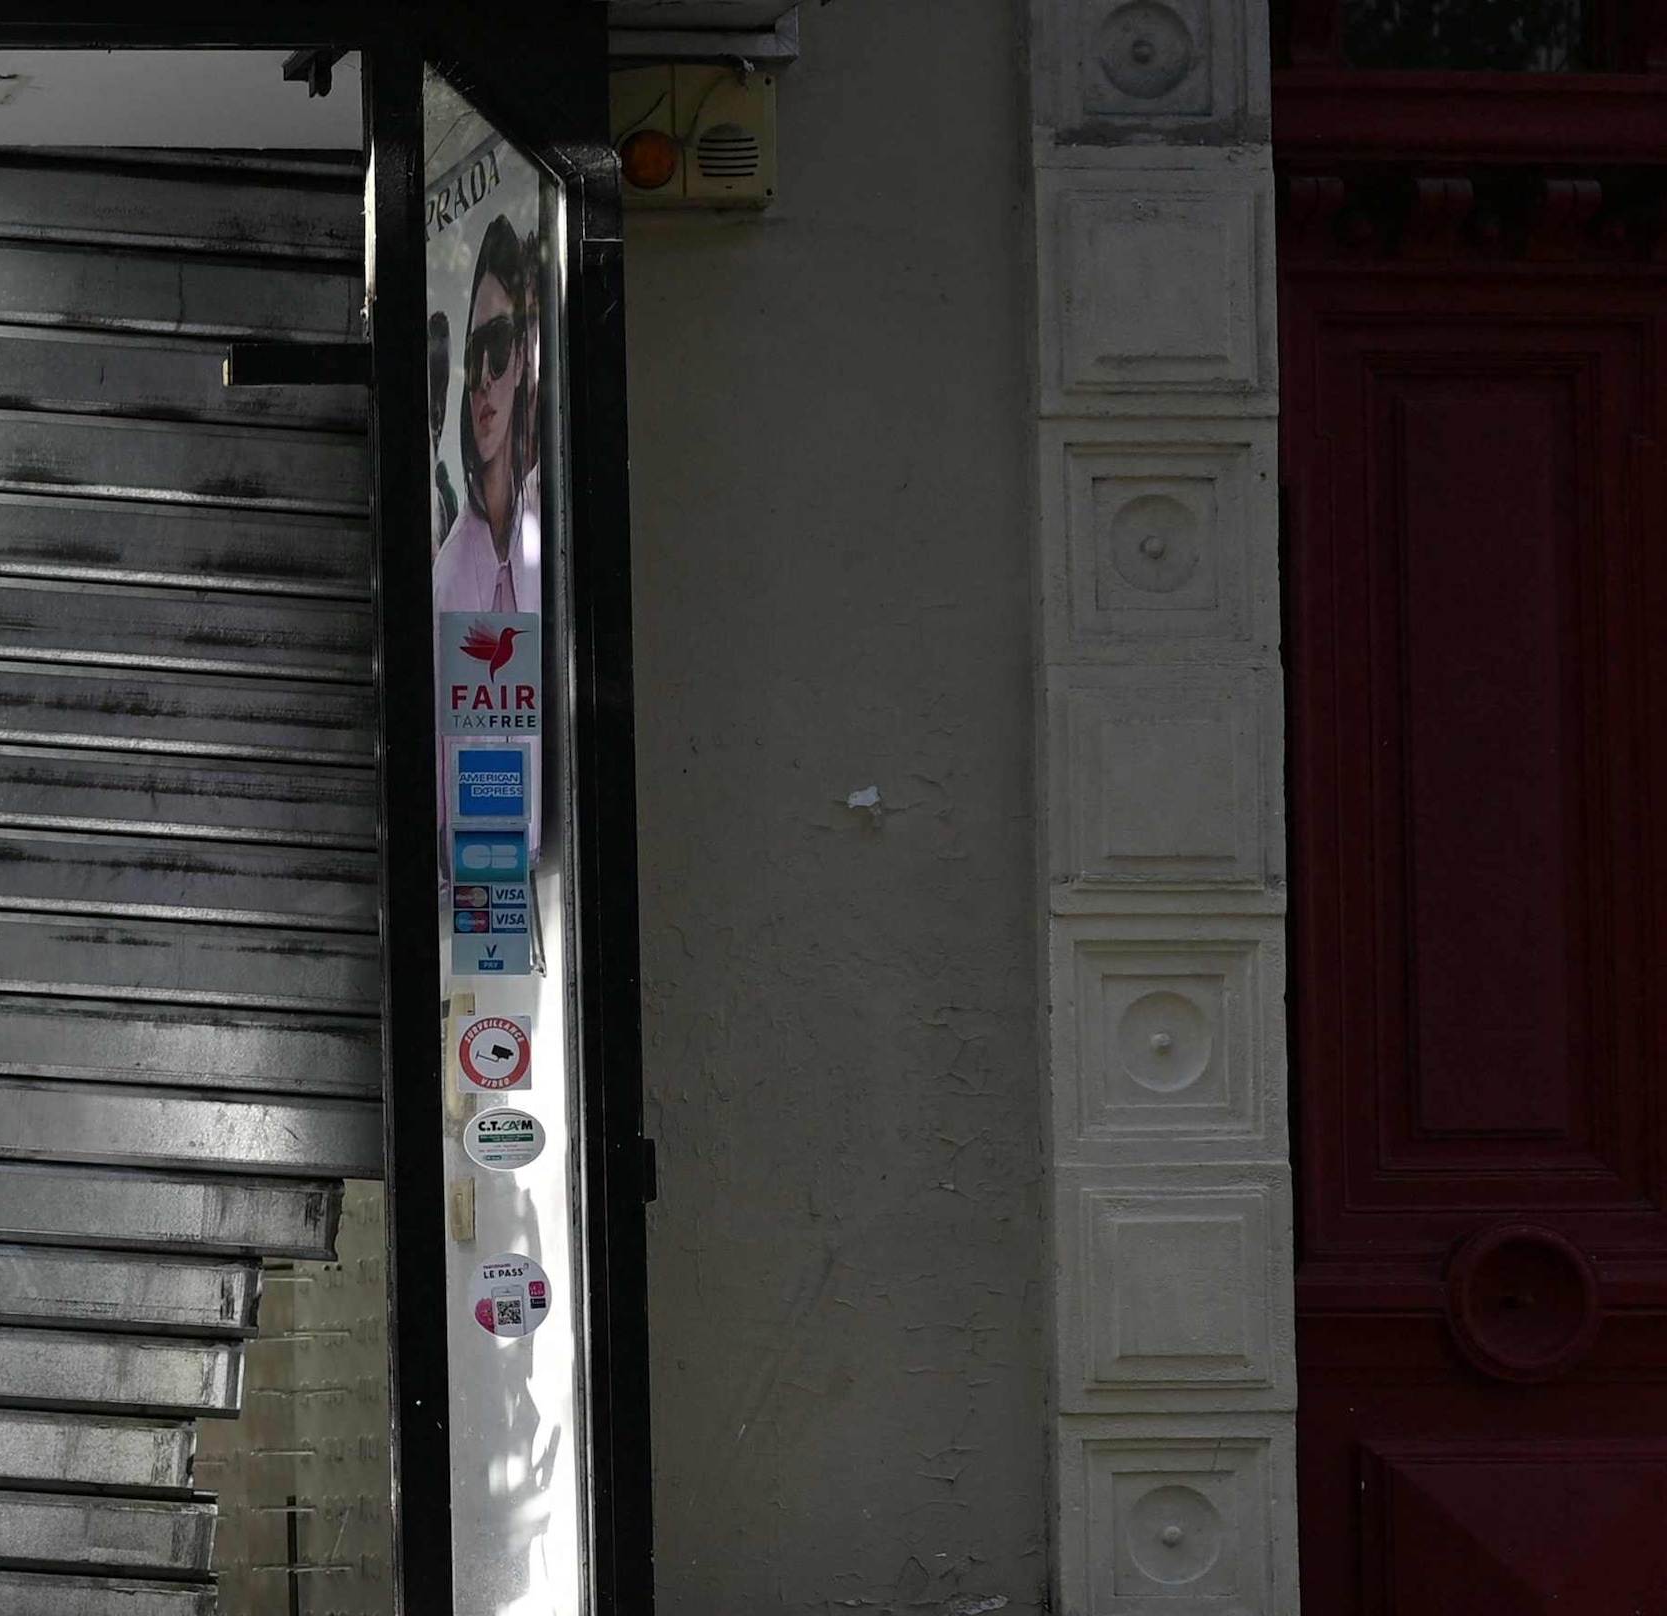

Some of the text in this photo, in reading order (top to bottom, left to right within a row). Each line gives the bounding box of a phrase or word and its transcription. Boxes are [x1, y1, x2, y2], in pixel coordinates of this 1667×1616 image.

[451, 684, 536, 710] FAIR
[459, 772, 519, 783] AMERICAN
[471, 784, 523, 797] EXPRESS
[495, 889, 525, 900] VISA
[495, 913, 525, 925] VISA
[465, 1018, 526, 1044] SURVEILLANCE
[483, 1268, 524, 1279] LE PASS
